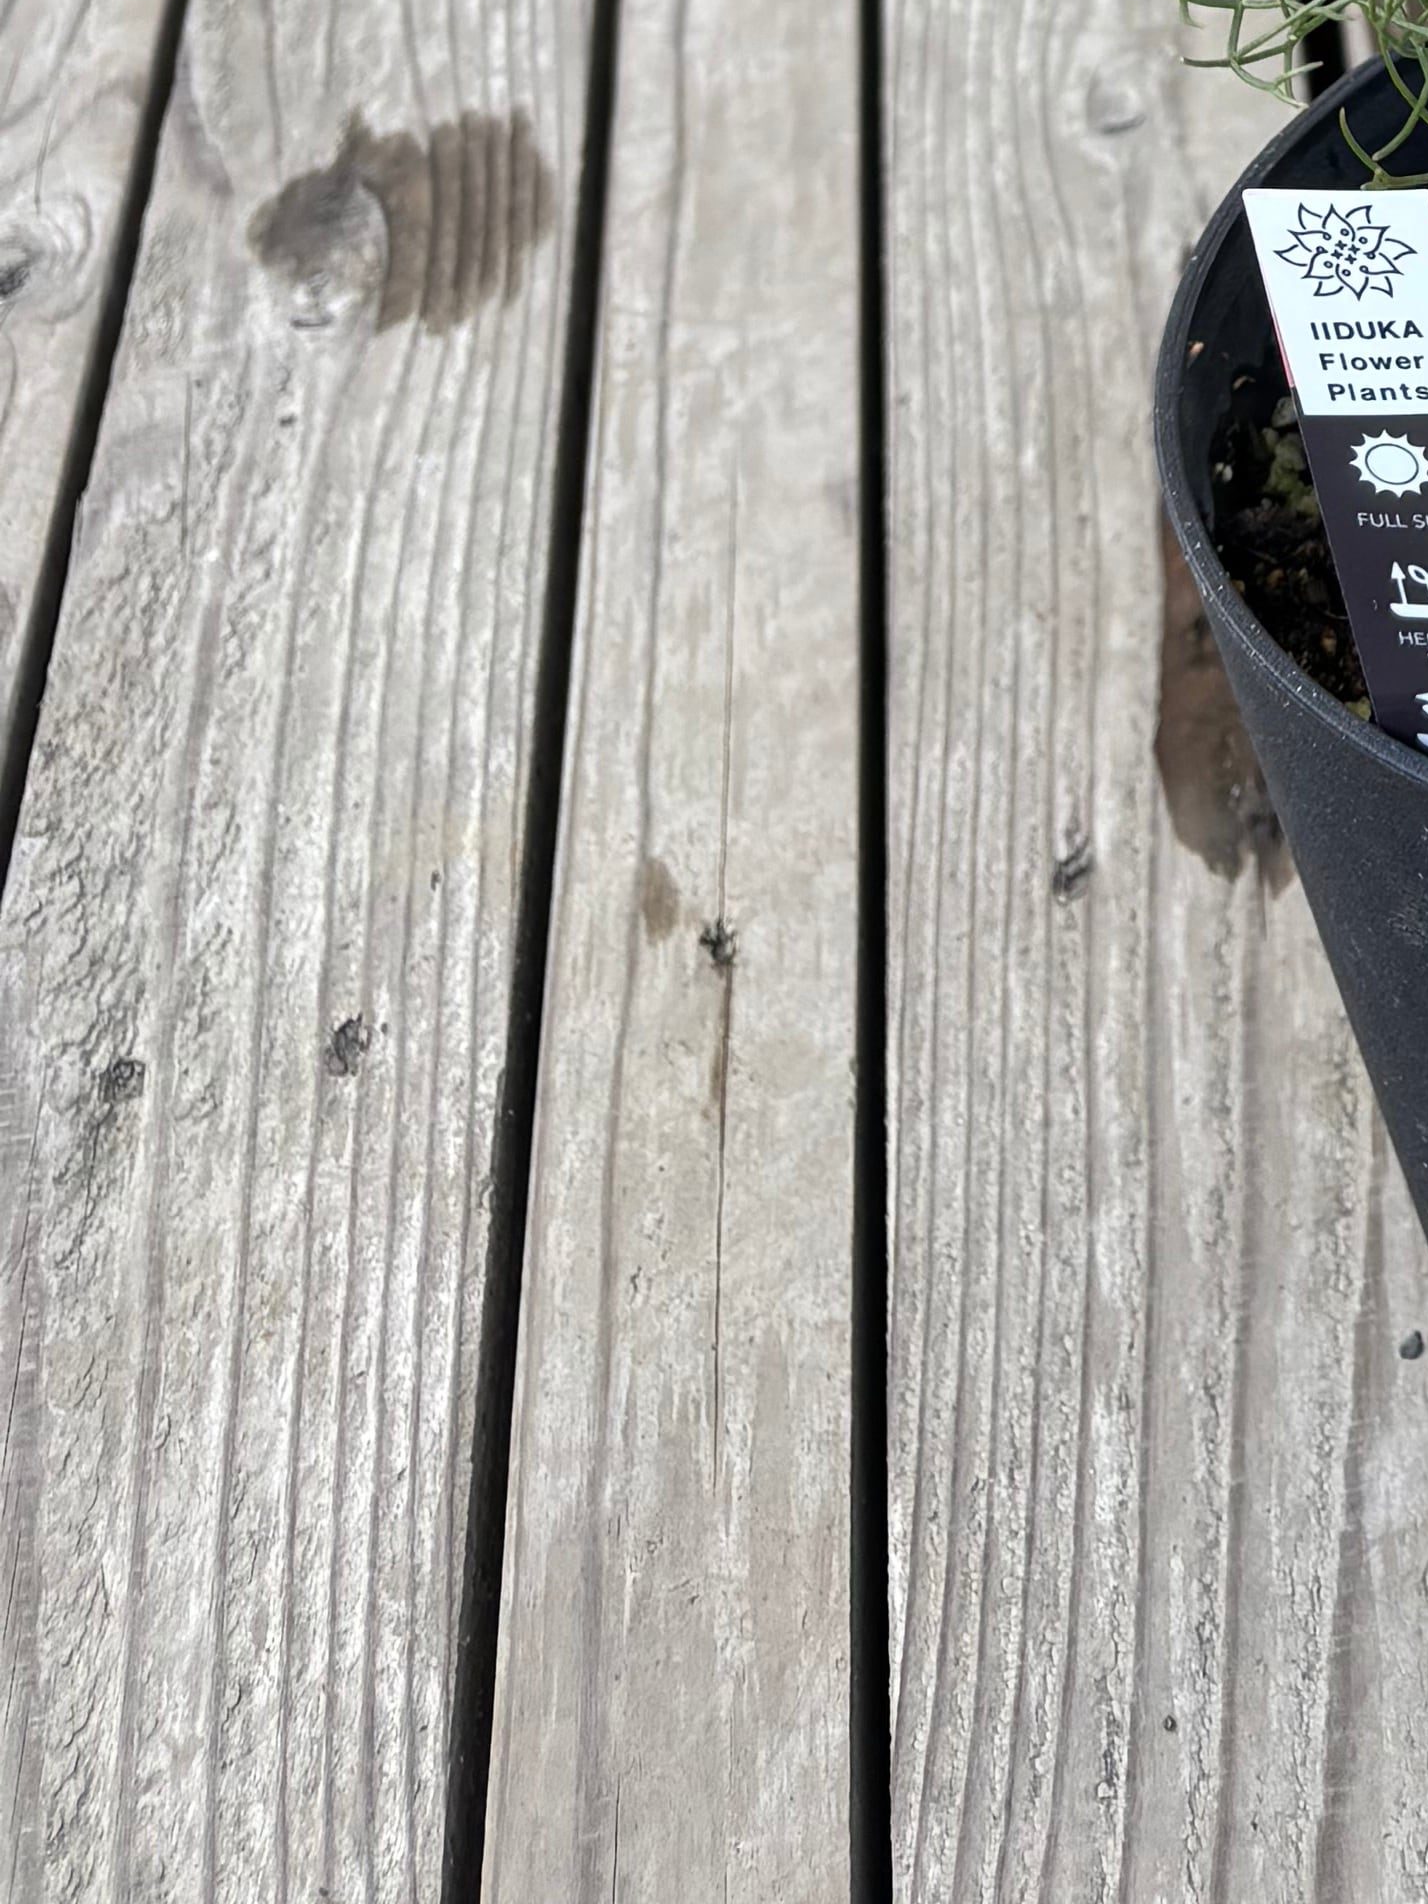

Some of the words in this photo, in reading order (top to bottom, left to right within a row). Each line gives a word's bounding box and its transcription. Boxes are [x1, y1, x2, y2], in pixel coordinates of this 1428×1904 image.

[1310, 320, 1424, 340] IIDUKA
[1319, 352, 1424, 371] Flower
[1357, 512, 1408, 528] FULL
